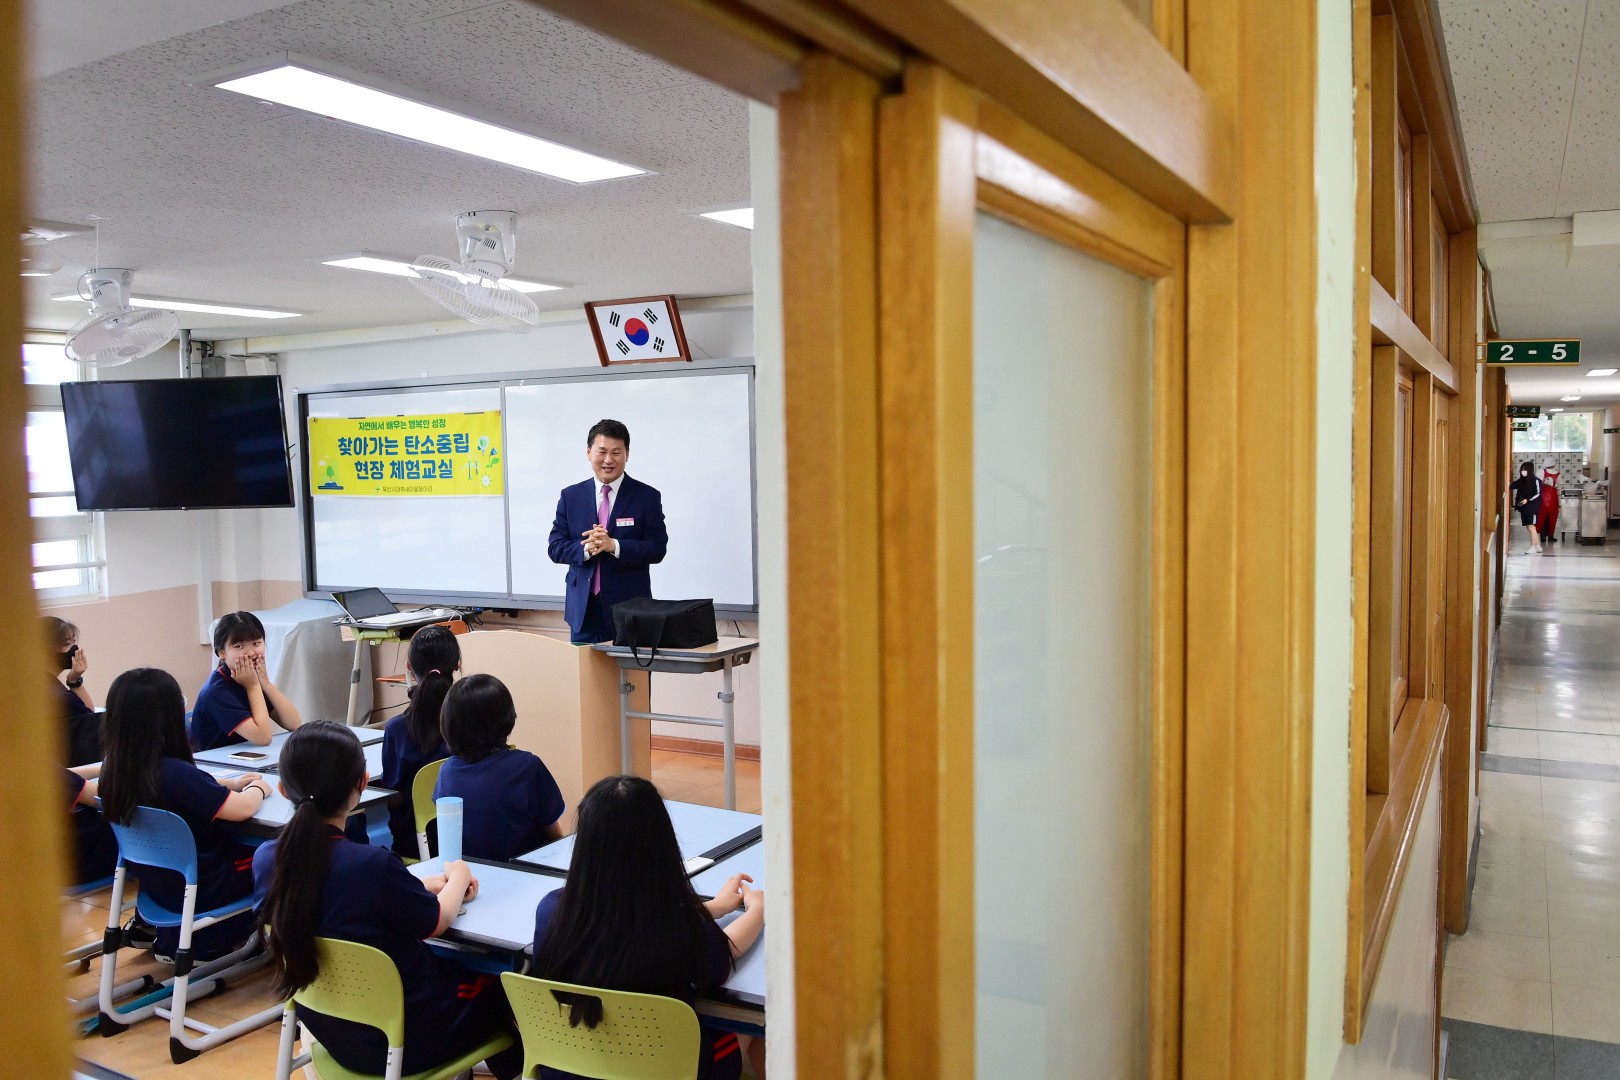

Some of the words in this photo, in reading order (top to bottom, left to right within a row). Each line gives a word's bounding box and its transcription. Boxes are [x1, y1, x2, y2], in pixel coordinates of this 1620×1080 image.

[358, 421, 385, 431] 자연에서
[386, 420, 407, 430] 배우는
[408, 419, 430, 429] 행복한
[431, 418, 446, 428] 성장
[337, 436, 399, 456] 찾아가는
[404, 432, 470, 455] 탄소중립
[354, 460, 385, 480] 현장
[389, 458, 454, 480] 체험교실
